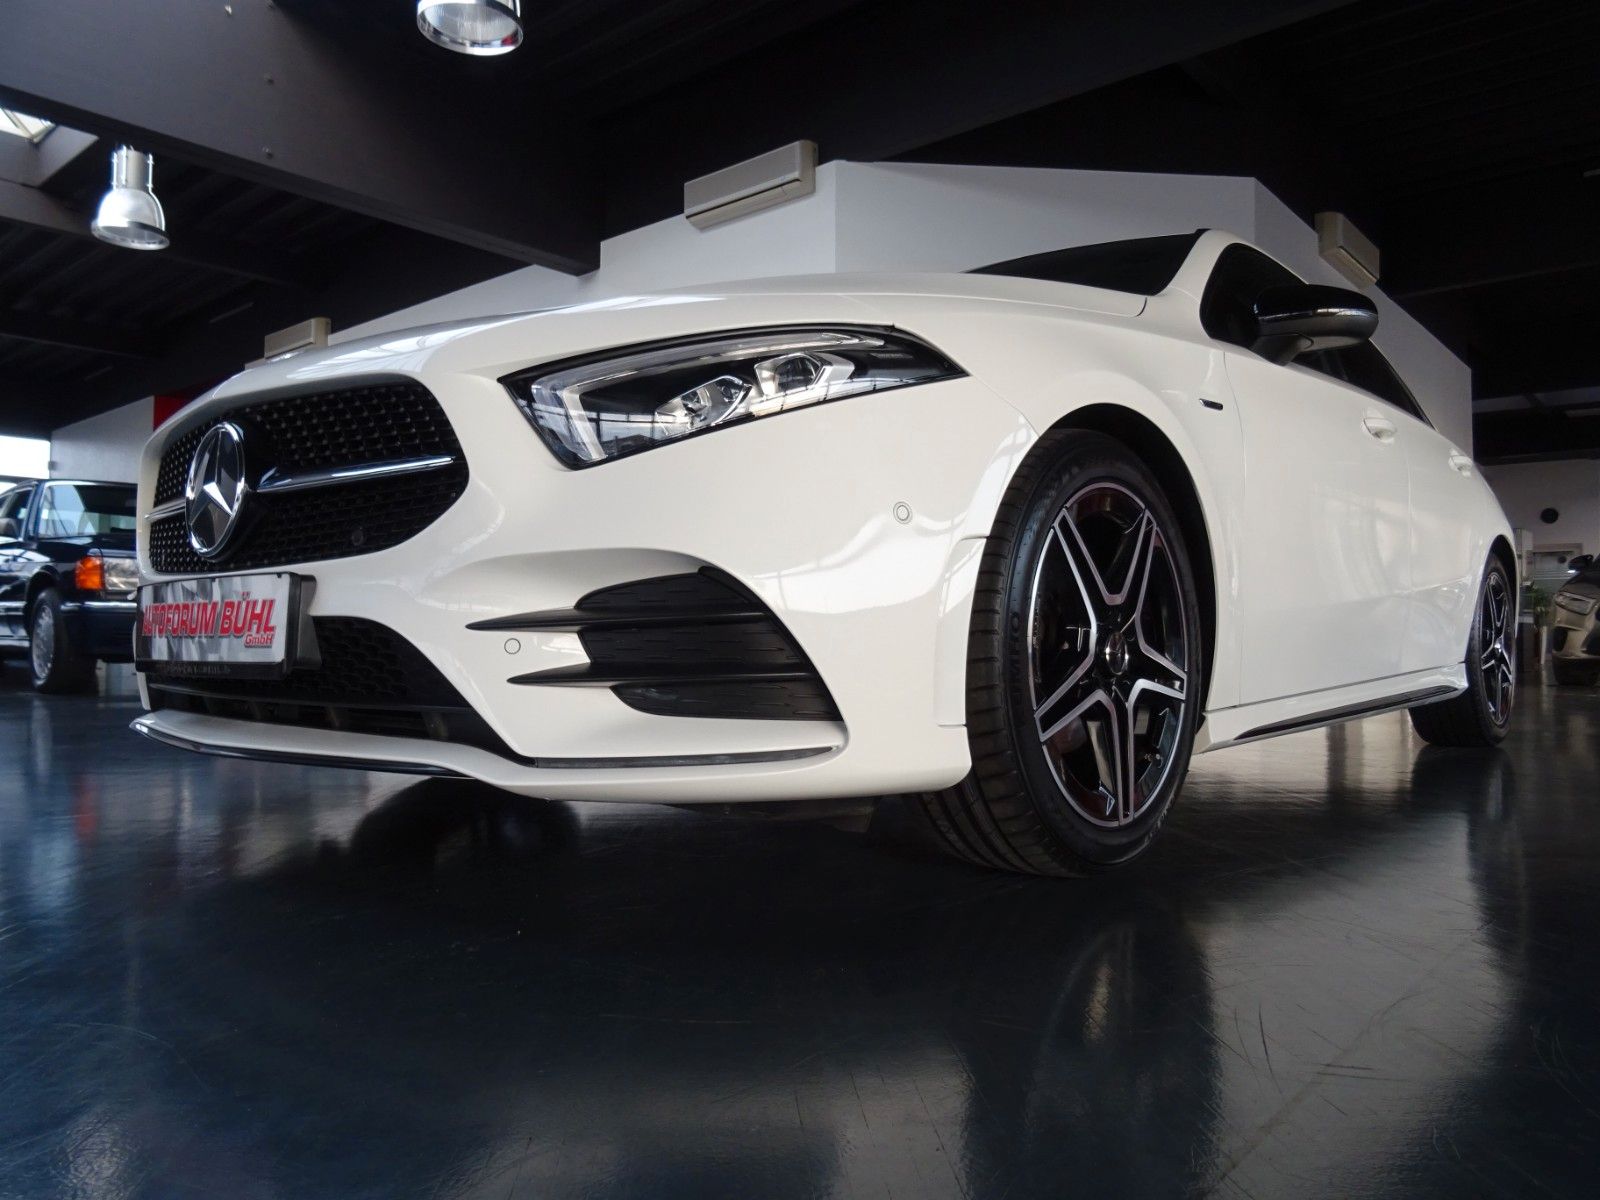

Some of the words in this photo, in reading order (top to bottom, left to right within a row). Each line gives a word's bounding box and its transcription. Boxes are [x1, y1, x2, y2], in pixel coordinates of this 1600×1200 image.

[141, 601, 218, 637] AUTOFORUM
[219, 591, 276, 637] BÜHL
[244, 633, 273, 648] GmbH
